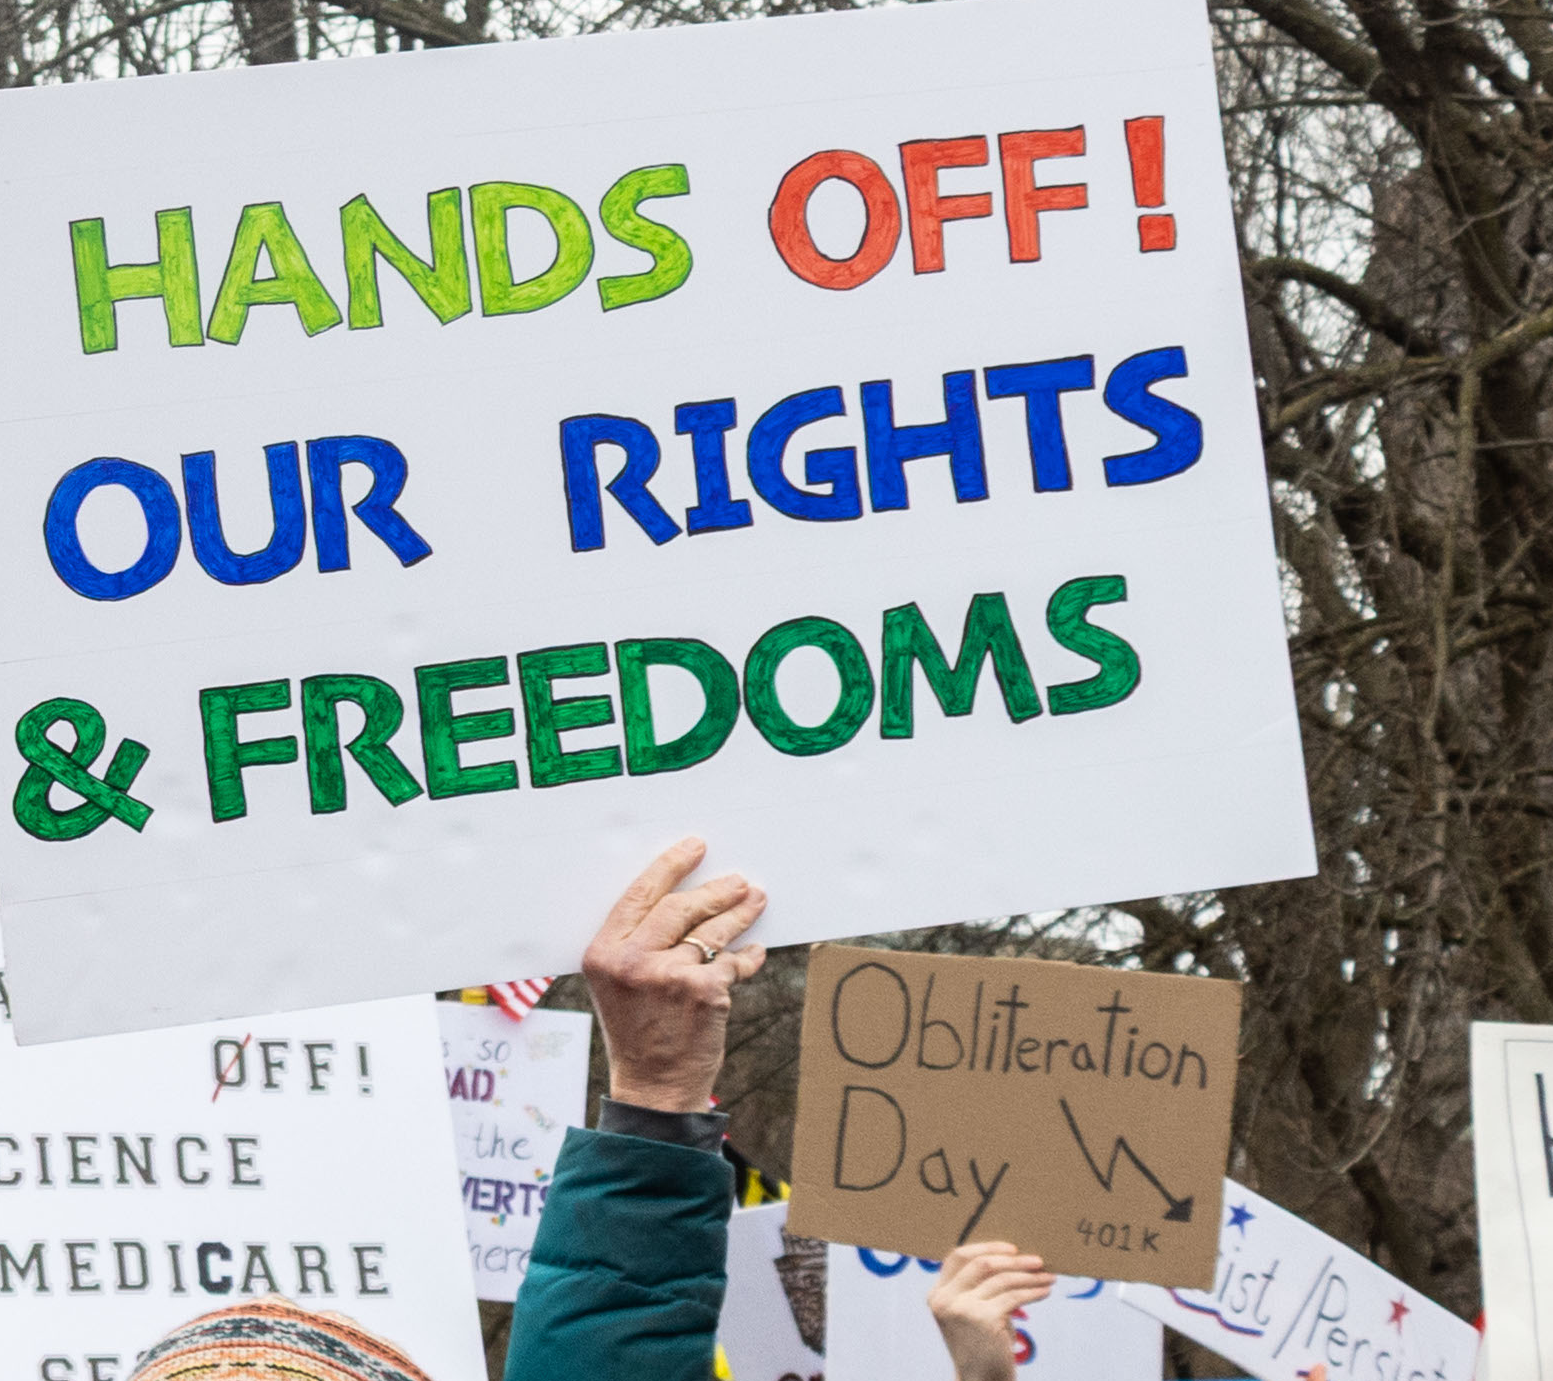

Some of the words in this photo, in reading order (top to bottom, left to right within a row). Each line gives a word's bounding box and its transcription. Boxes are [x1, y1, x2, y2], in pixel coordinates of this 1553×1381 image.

[69, 163, 692, 354] HANDS
[43, 435, 433, 602] OUR
[560, 345, 1206, 552] RIGHTS
[13, 697, 154, 843] &
[197, 575, 1142, 823] FREEDOMS
[831, 961, 1209, 1090] Obliteration
[471, 1123, 534, 1161] the
[834, 1085, 1010, 1246] Day
